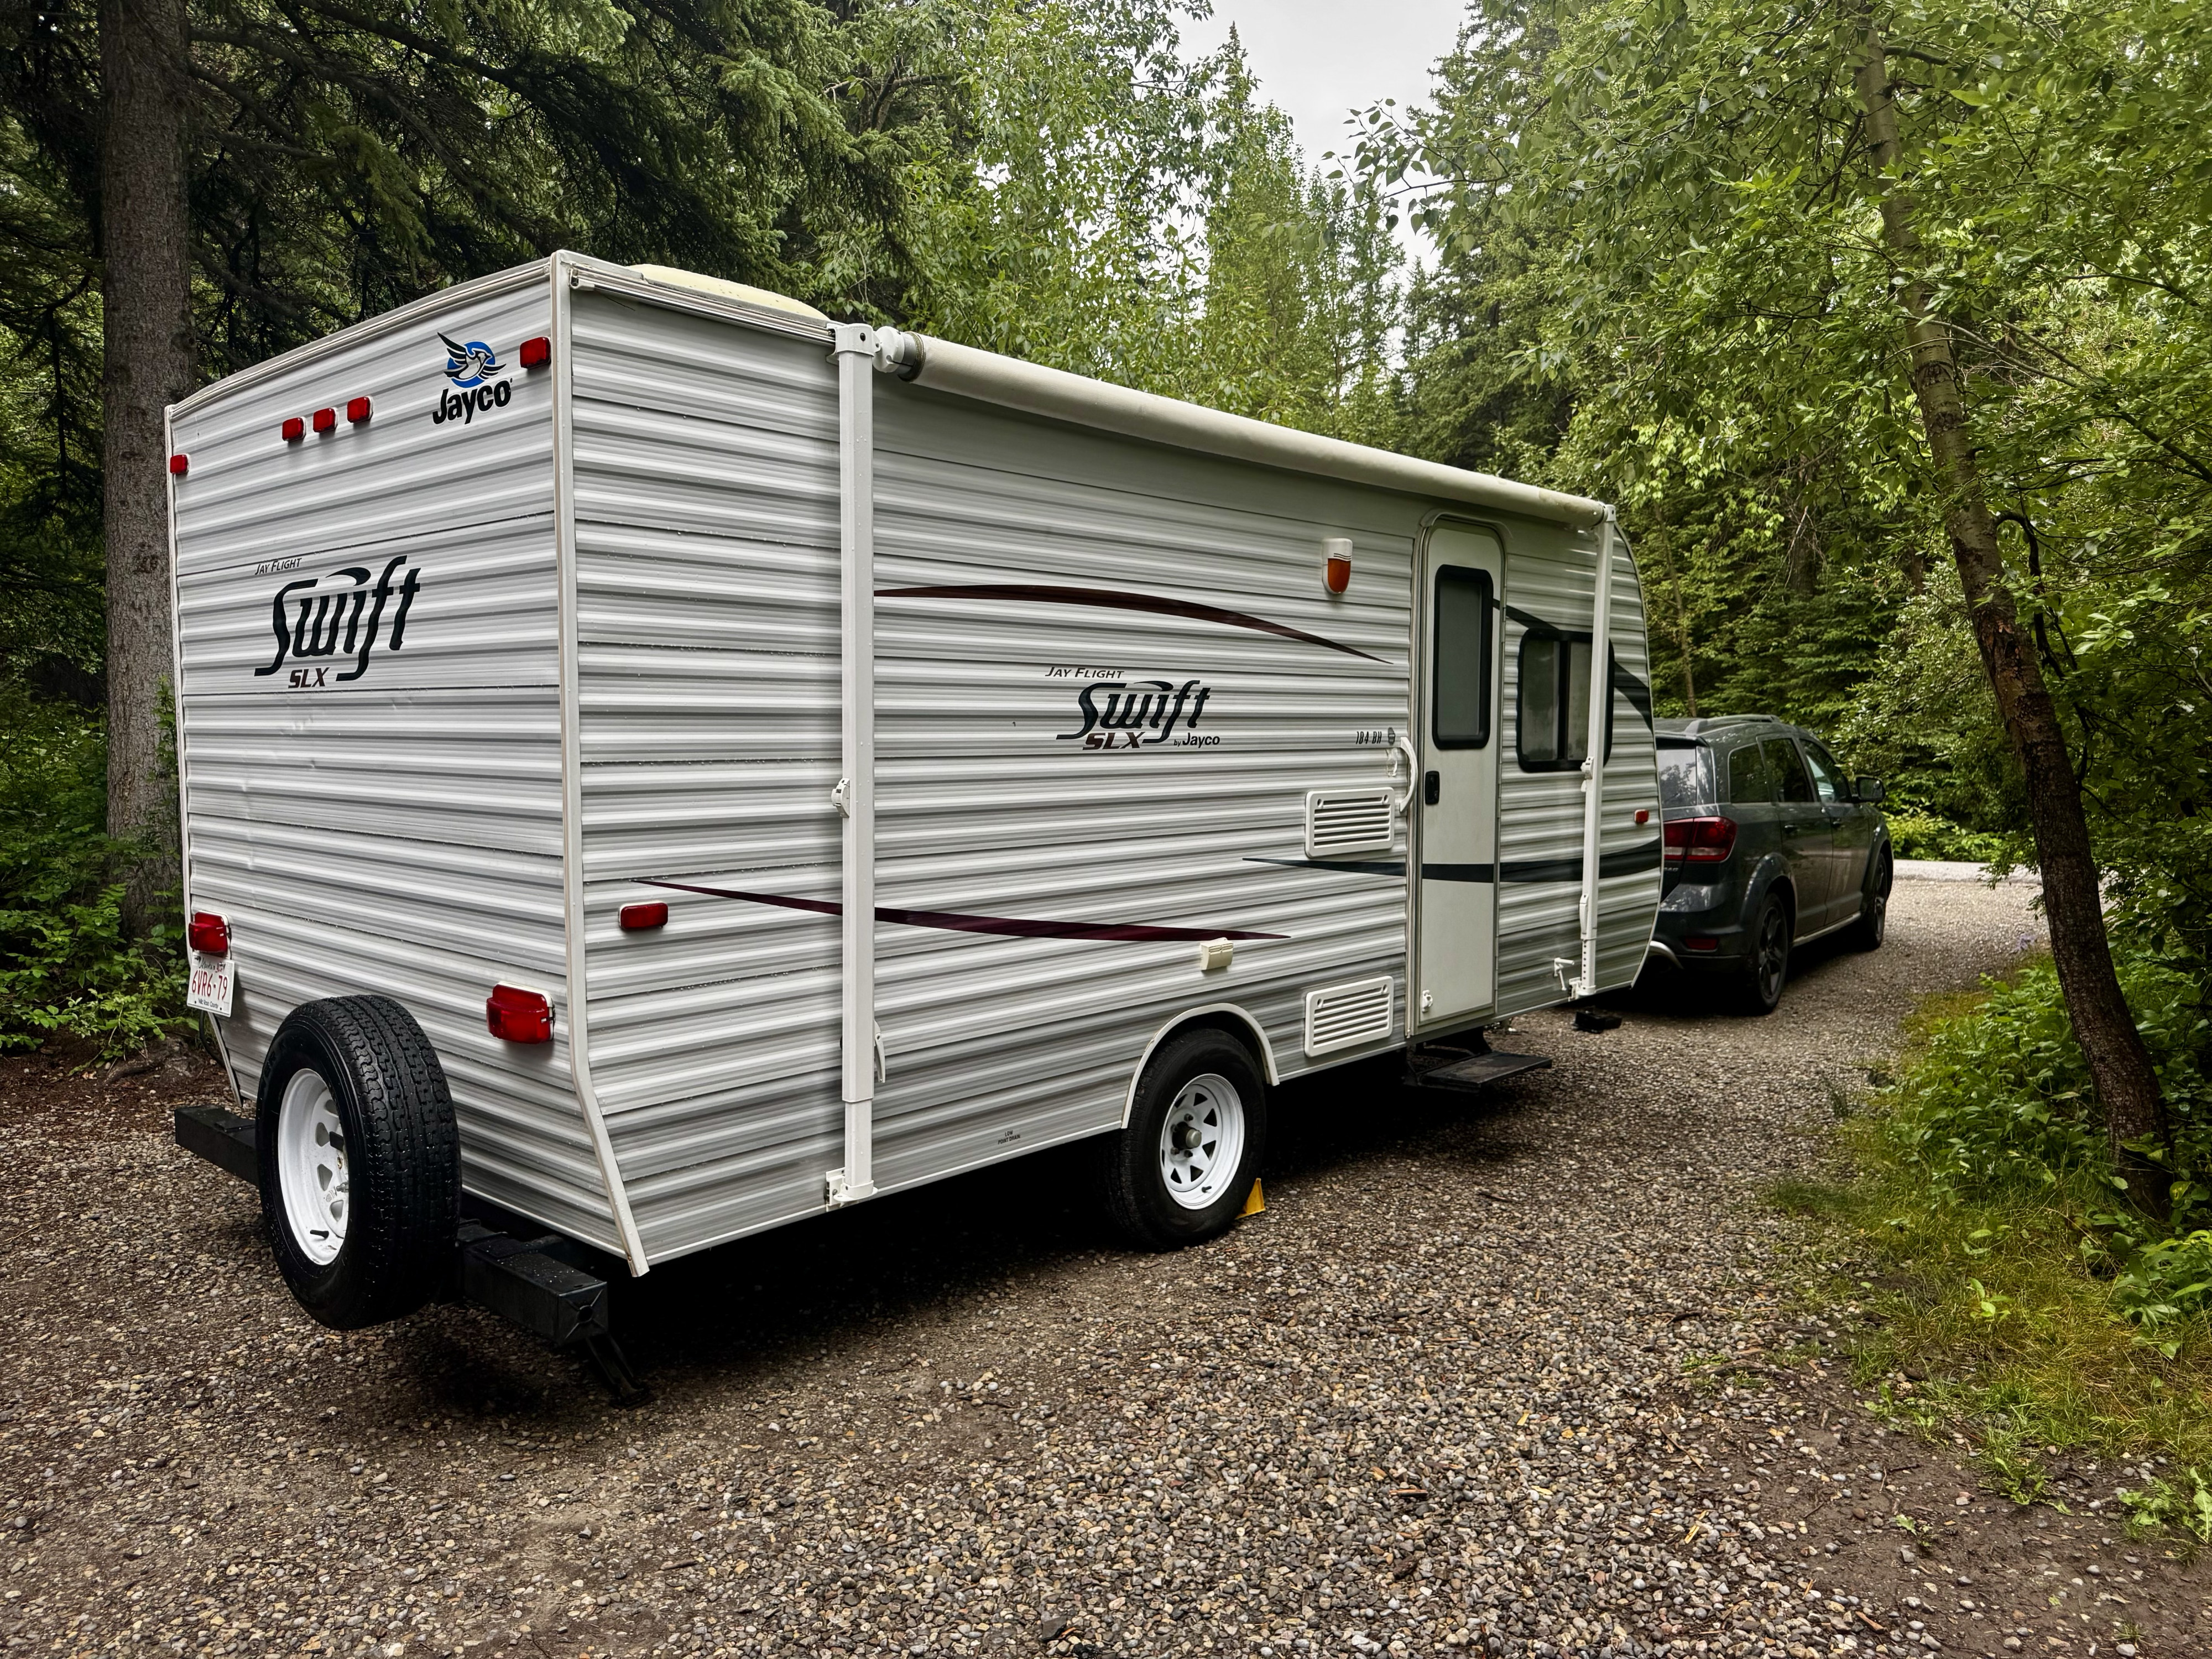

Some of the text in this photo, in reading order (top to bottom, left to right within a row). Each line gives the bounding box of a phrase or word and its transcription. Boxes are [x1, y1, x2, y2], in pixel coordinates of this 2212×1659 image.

[432, 380, 512, 425] Jayco
[254, 558, 302, 575] JAY FLIGHT
[254, 555, 421, 681] Swift
[288, 667, 330, 688] SLX
[1045, 667, 1124, 679] JAY FLIGHT
[1056, 680, 1211, 743] Swift
[1082, 732, 1146, 750] SLX
[1173, 732, 1220, 748] by Jayco
[1356, 731, 1382, 744] 184 BH
